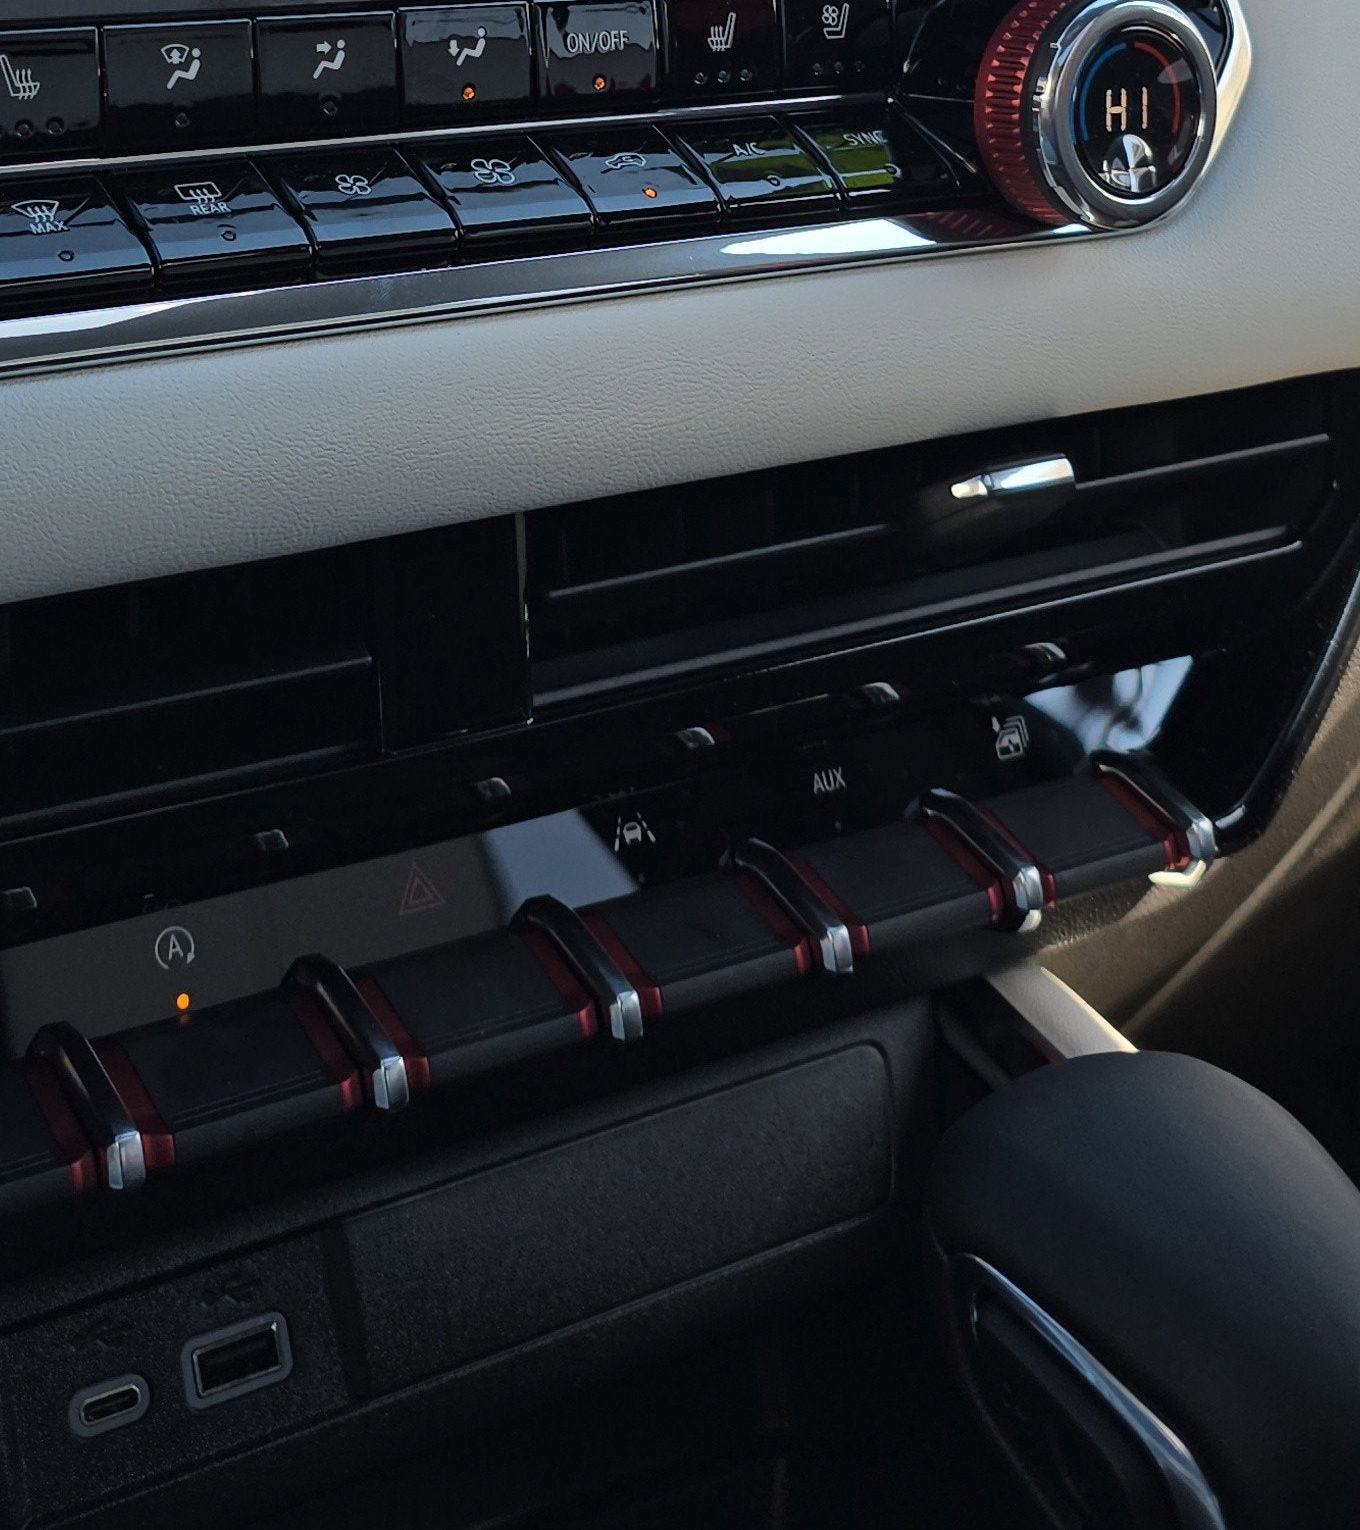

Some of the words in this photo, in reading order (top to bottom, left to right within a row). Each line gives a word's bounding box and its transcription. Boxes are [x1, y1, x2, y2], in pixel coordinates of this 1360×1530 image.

[566, 30, 628, 53] ON/OFF
[1105, 86, 1148, 132] HI
[843, 130, 888, 146] SYNC
[732, 142, 765, 156] A/C
[189, 201, 232, 216] REAR
[29, 221, 68, 236] MAX
[813, 766, 847, 795] AUX
